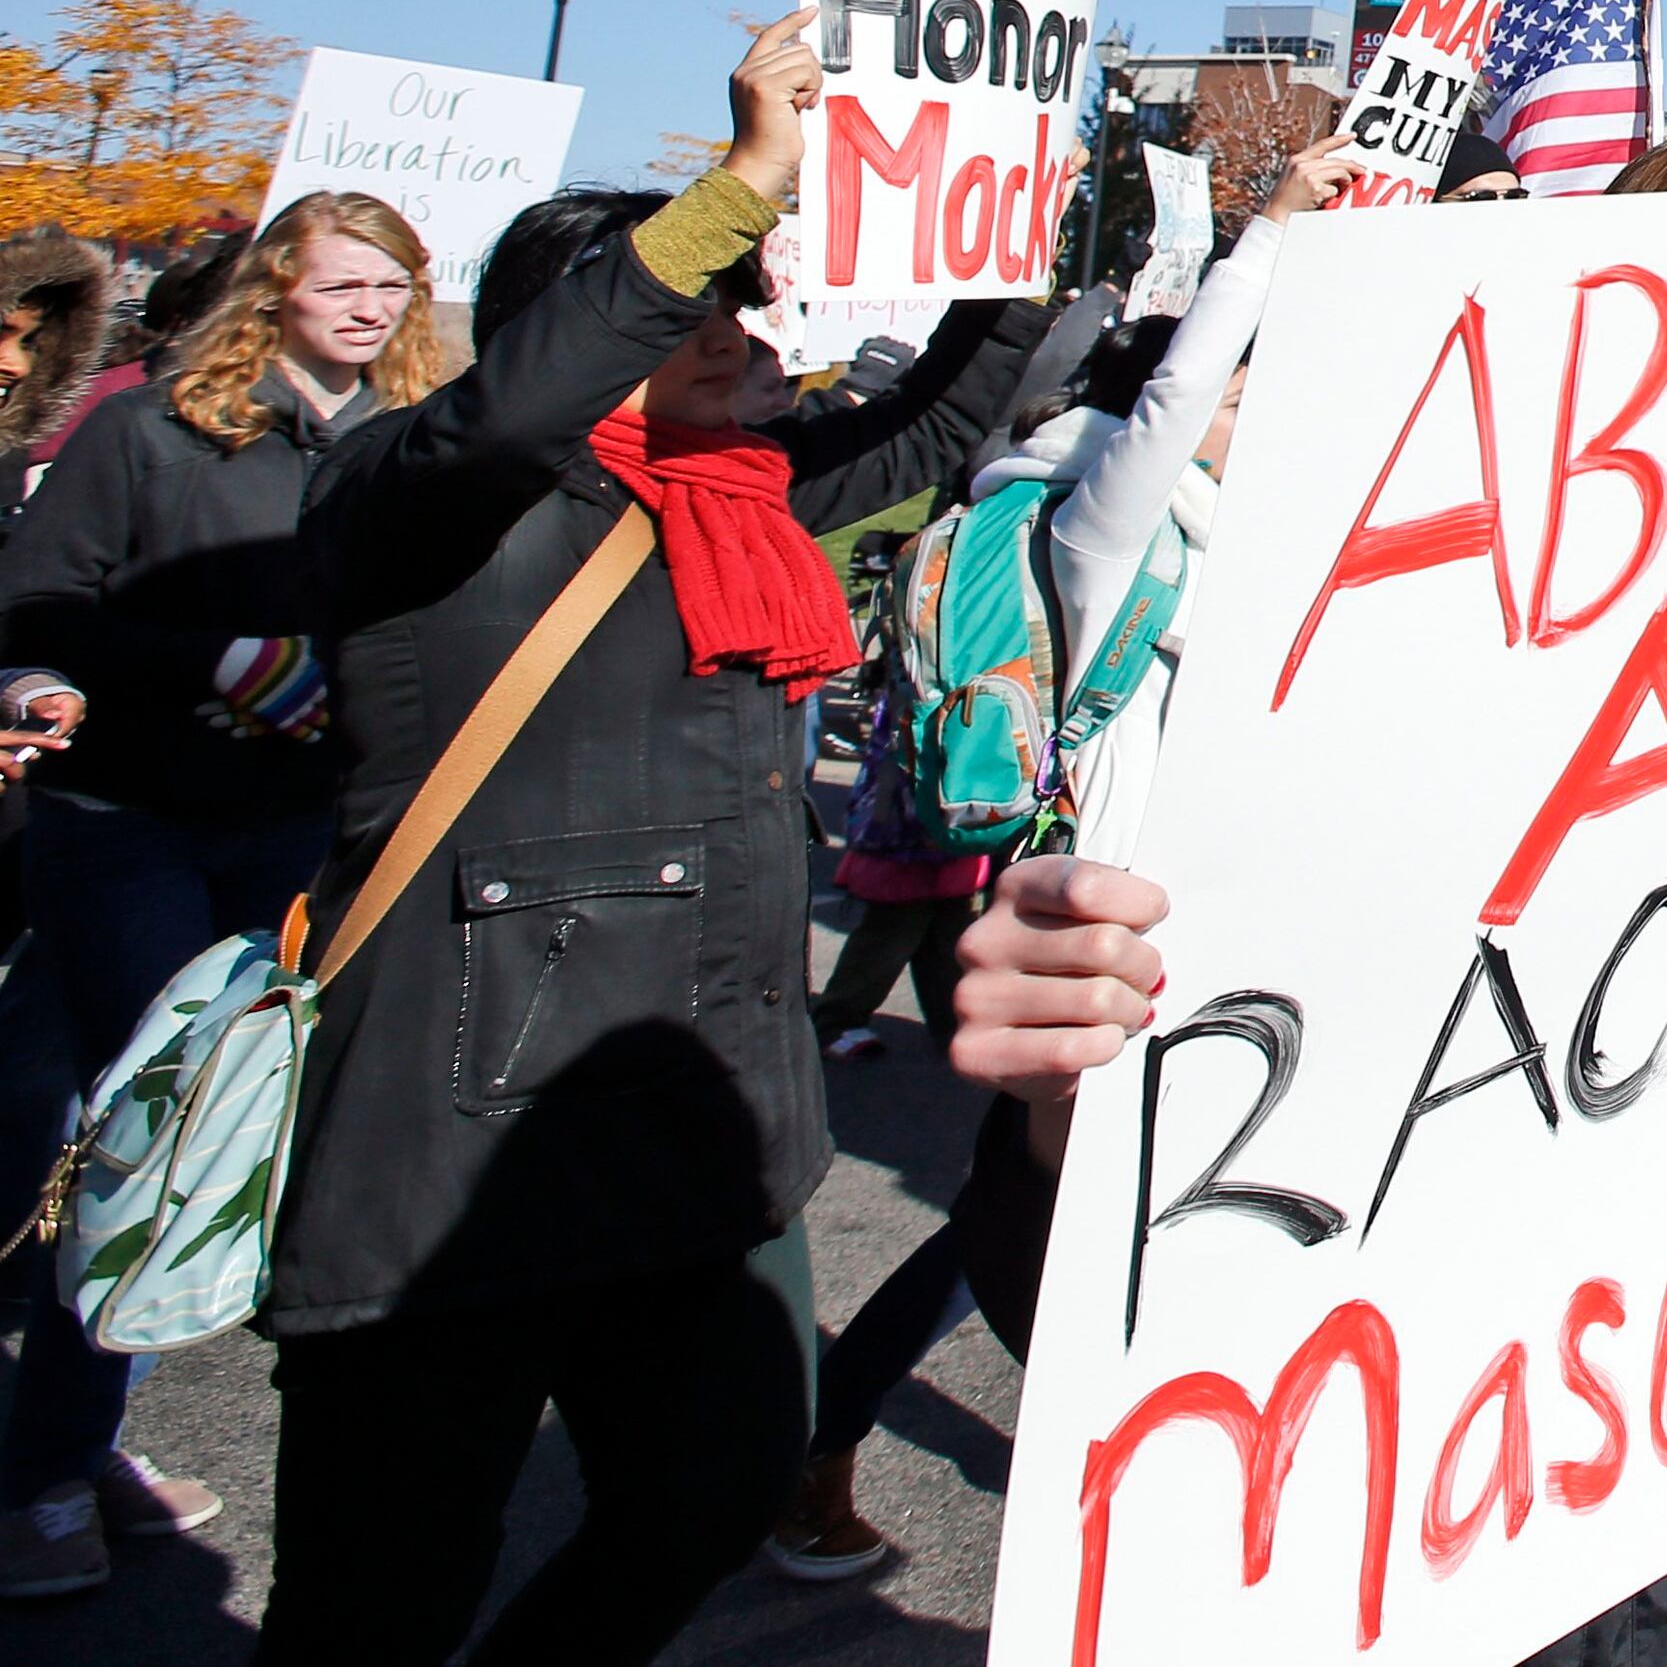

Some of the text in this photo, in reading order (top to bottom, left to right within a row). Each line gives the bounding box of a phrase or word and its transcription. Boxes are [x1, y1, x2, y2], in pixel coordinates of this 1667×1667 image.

[388, 71, 476, 120] Our
[1369, 55, 1468, 119] MY
[294, 110, 532, 184] Liberation
[1106, 597, 1153, 669] DAKINE
